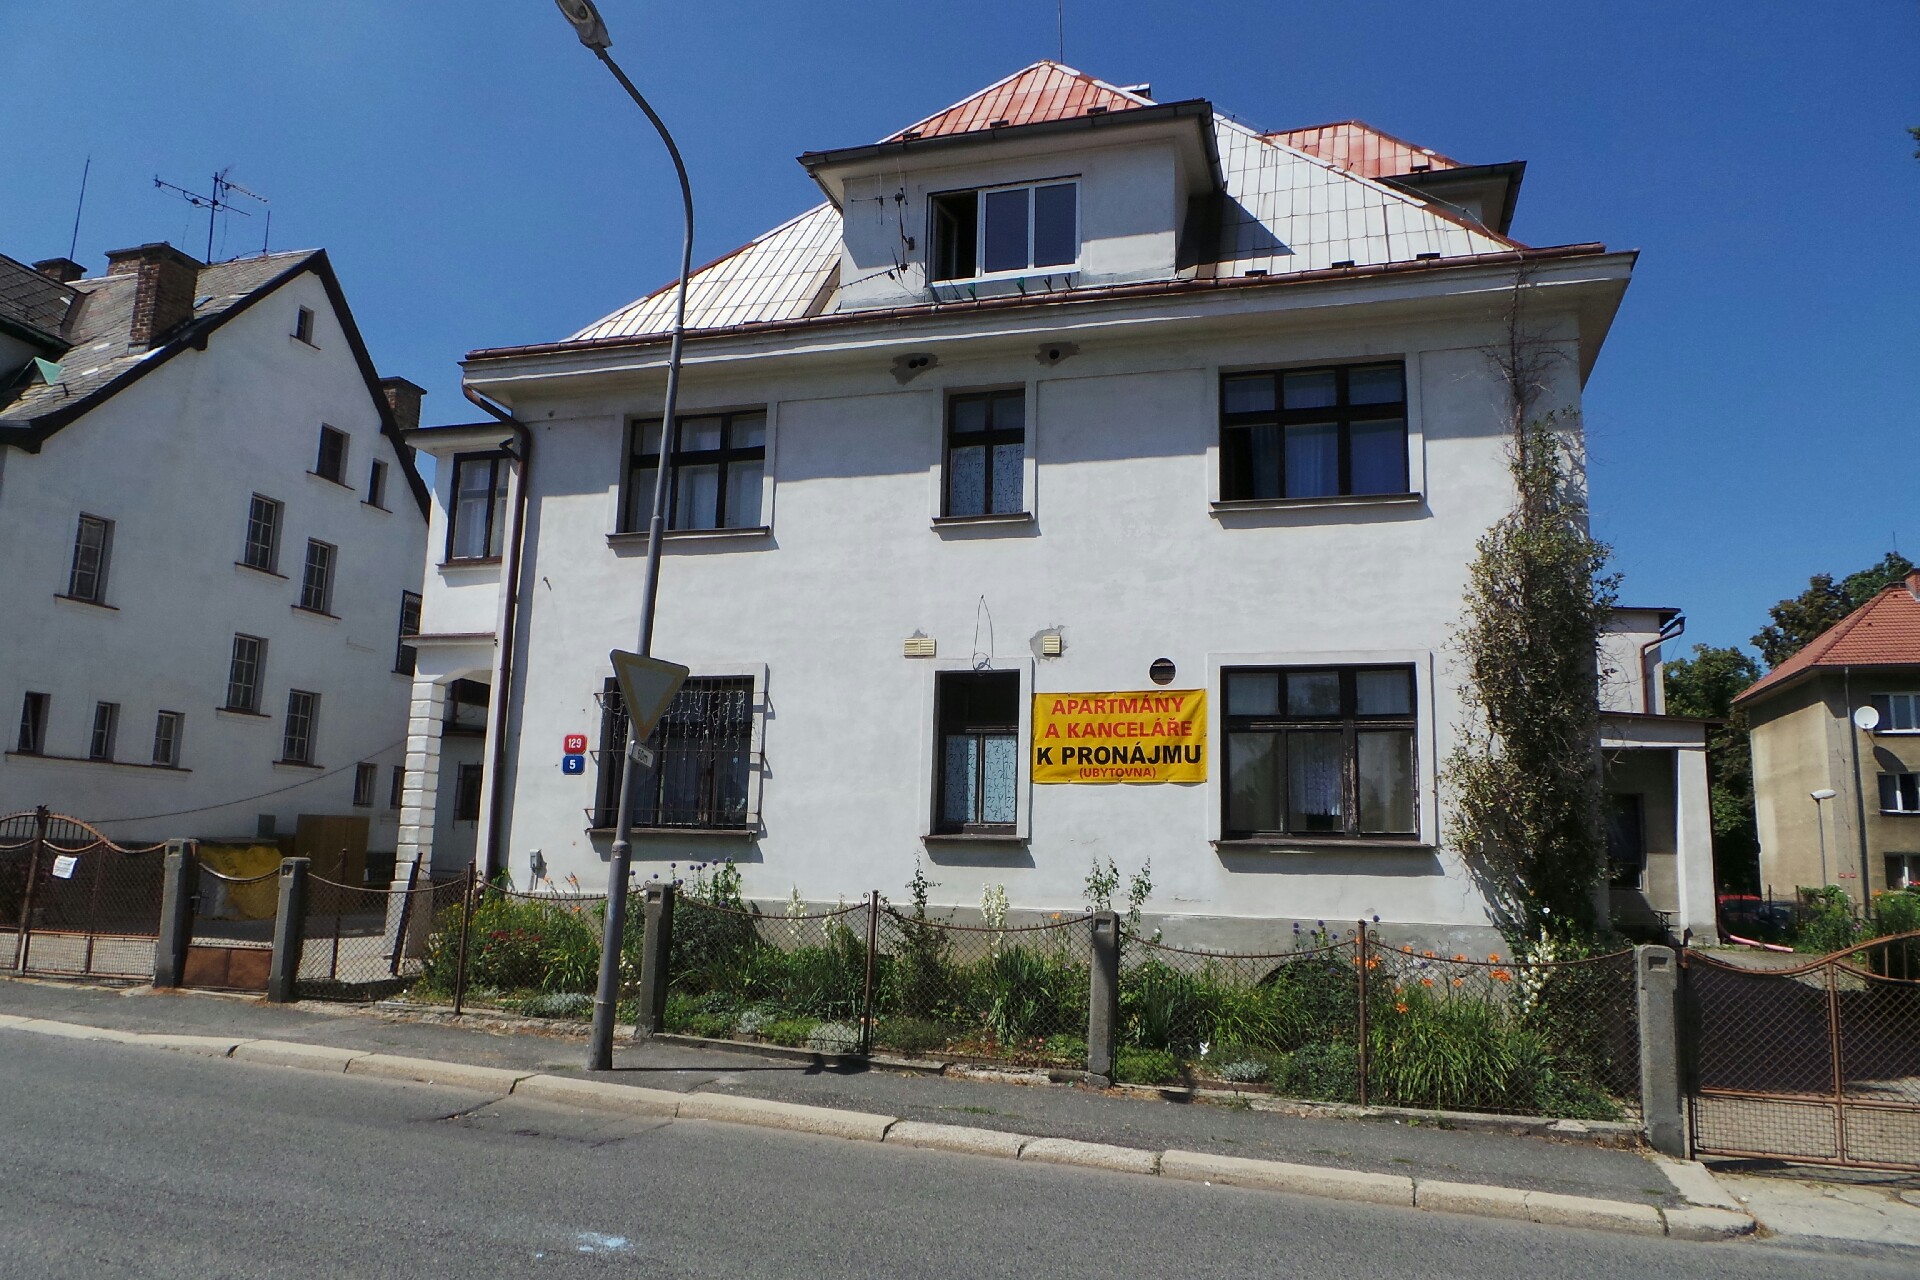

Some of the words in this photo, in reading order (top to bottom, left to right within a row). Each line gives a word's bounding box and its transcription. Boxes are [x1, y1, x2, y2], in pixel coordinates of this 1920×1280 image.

[1051, 695, 1185, 715] APARTMÁNY
[1044, 722, 1060, 739] A
[1067, 718, 1193, 738] KANCELÁŘE
[568, 738, 582, 748] 129
[1036, 746, 1053, 765] K
[1061, 742, 1201, 765] PRONÁJMU
[569, 759, 576, 769] 5
[1079, 767, 1156, 779] (UBYTOVNA)
